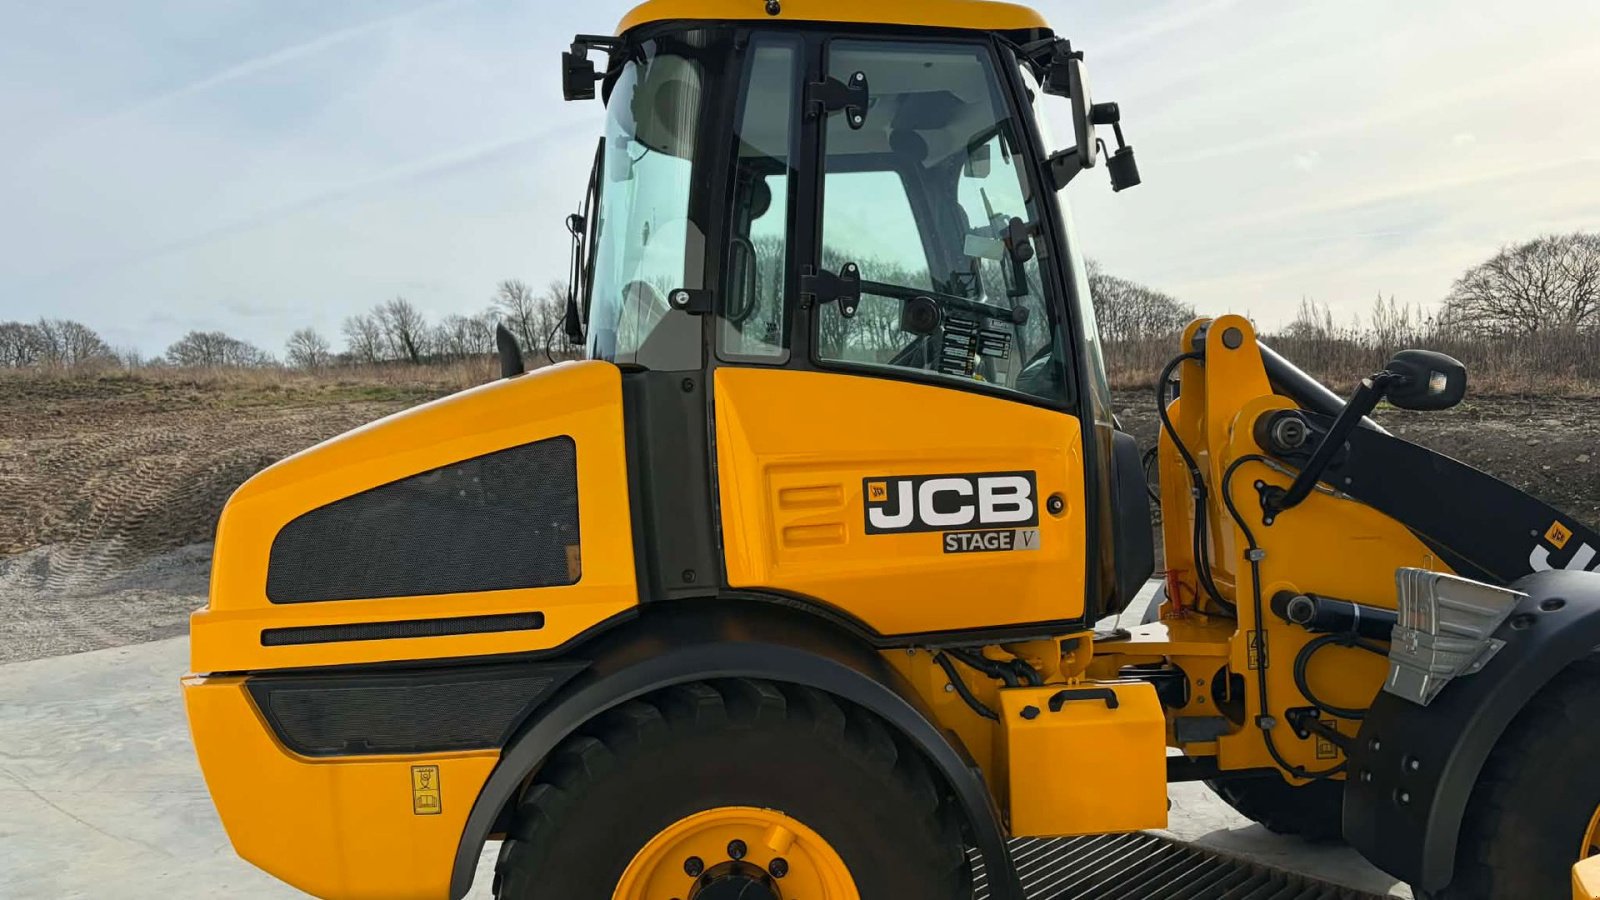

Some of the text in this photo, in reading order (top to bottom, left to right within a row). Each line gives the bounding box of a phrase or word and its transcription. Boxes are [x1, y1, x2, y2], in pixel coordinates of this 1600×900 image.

[869, 476, 1034, 528] JCB
[946, 531, 1035, 550] STAGE V
